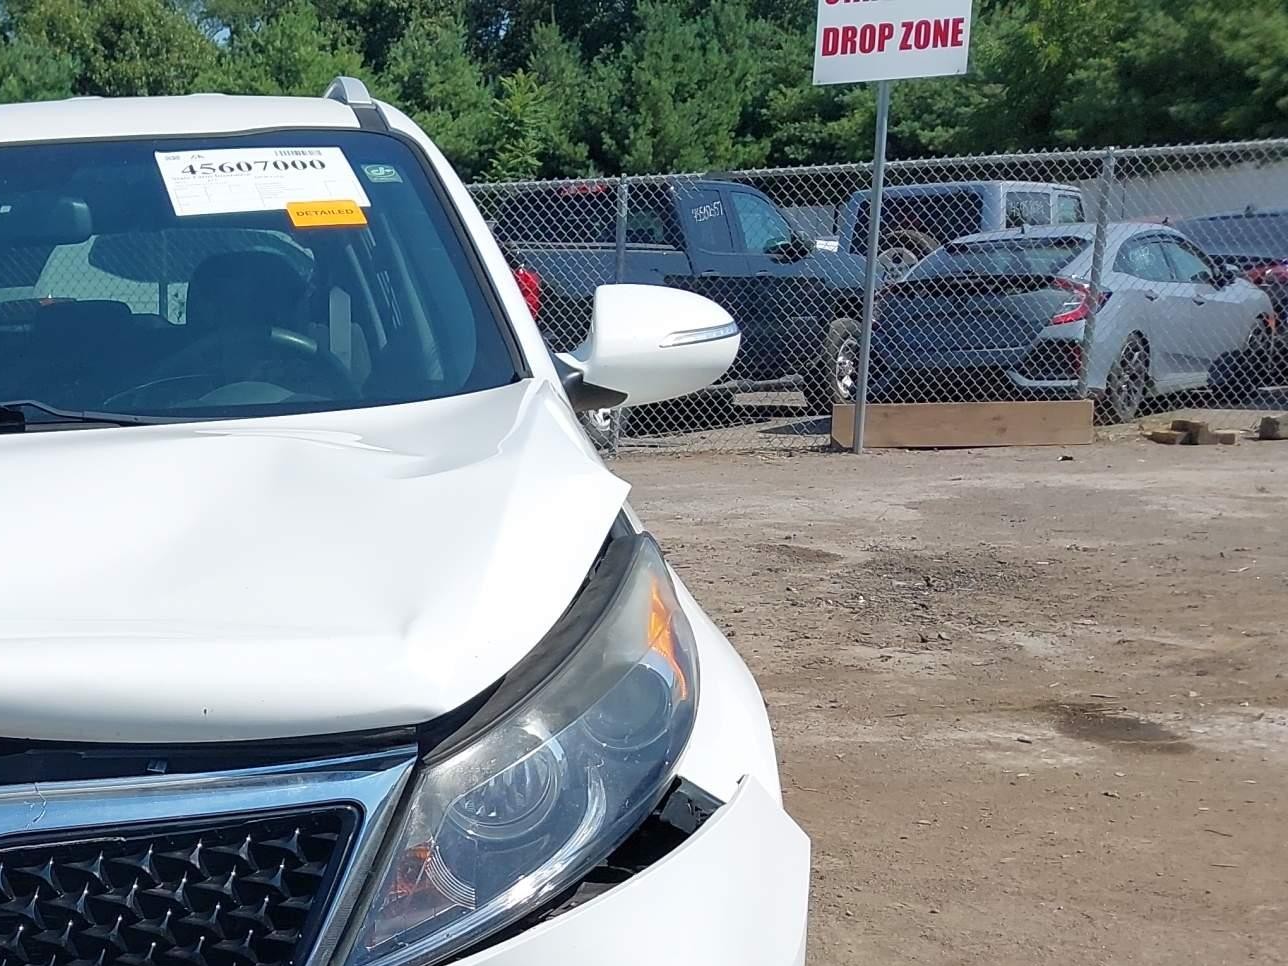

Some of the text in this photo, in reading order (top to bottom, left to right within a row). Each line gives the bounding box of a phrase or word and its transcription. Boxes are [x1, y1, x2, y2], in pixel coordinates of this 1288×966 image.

[821, 17, 965, 57] DROP ZONE
[181, 159, 326, 175] 45607000
[295, 208, 355, 217] DETAILED
